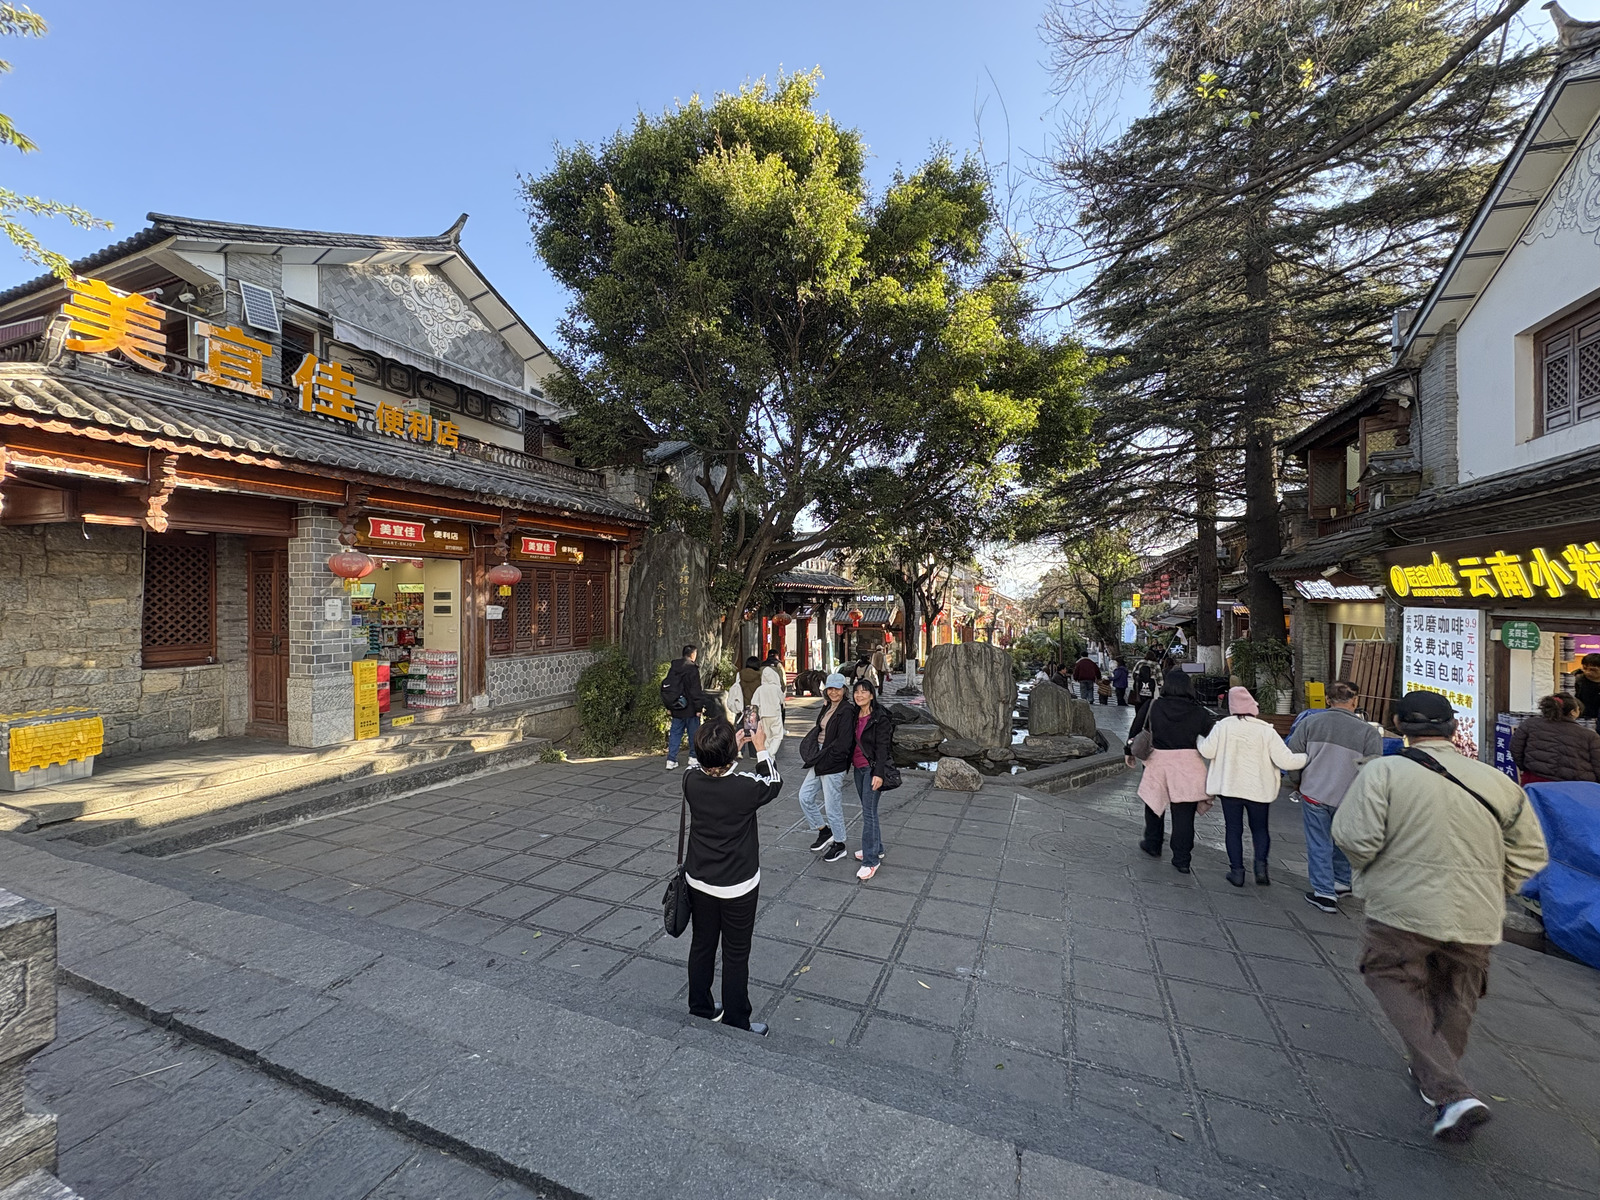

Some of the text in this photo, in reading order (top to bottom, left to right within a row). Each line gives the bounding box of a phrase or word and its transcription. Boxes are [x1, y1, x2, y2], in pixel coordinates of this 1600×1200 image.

[61, 276, 460, 449] 美宜佳 便利店
[380, 523, 459, 540] 美宜佳 便利店
[528, 541, 550, 552] 美宜佳
[1413, 614, 1464, 635] 现磨咖啡
[1508, 628, 1535, 637] 买四送一
[1413, 636, 1464, 660] 免费试喝
[1508, 639, 1535, 649] 买六送二
[1413, 658, 1464, 685] 全国包邮
